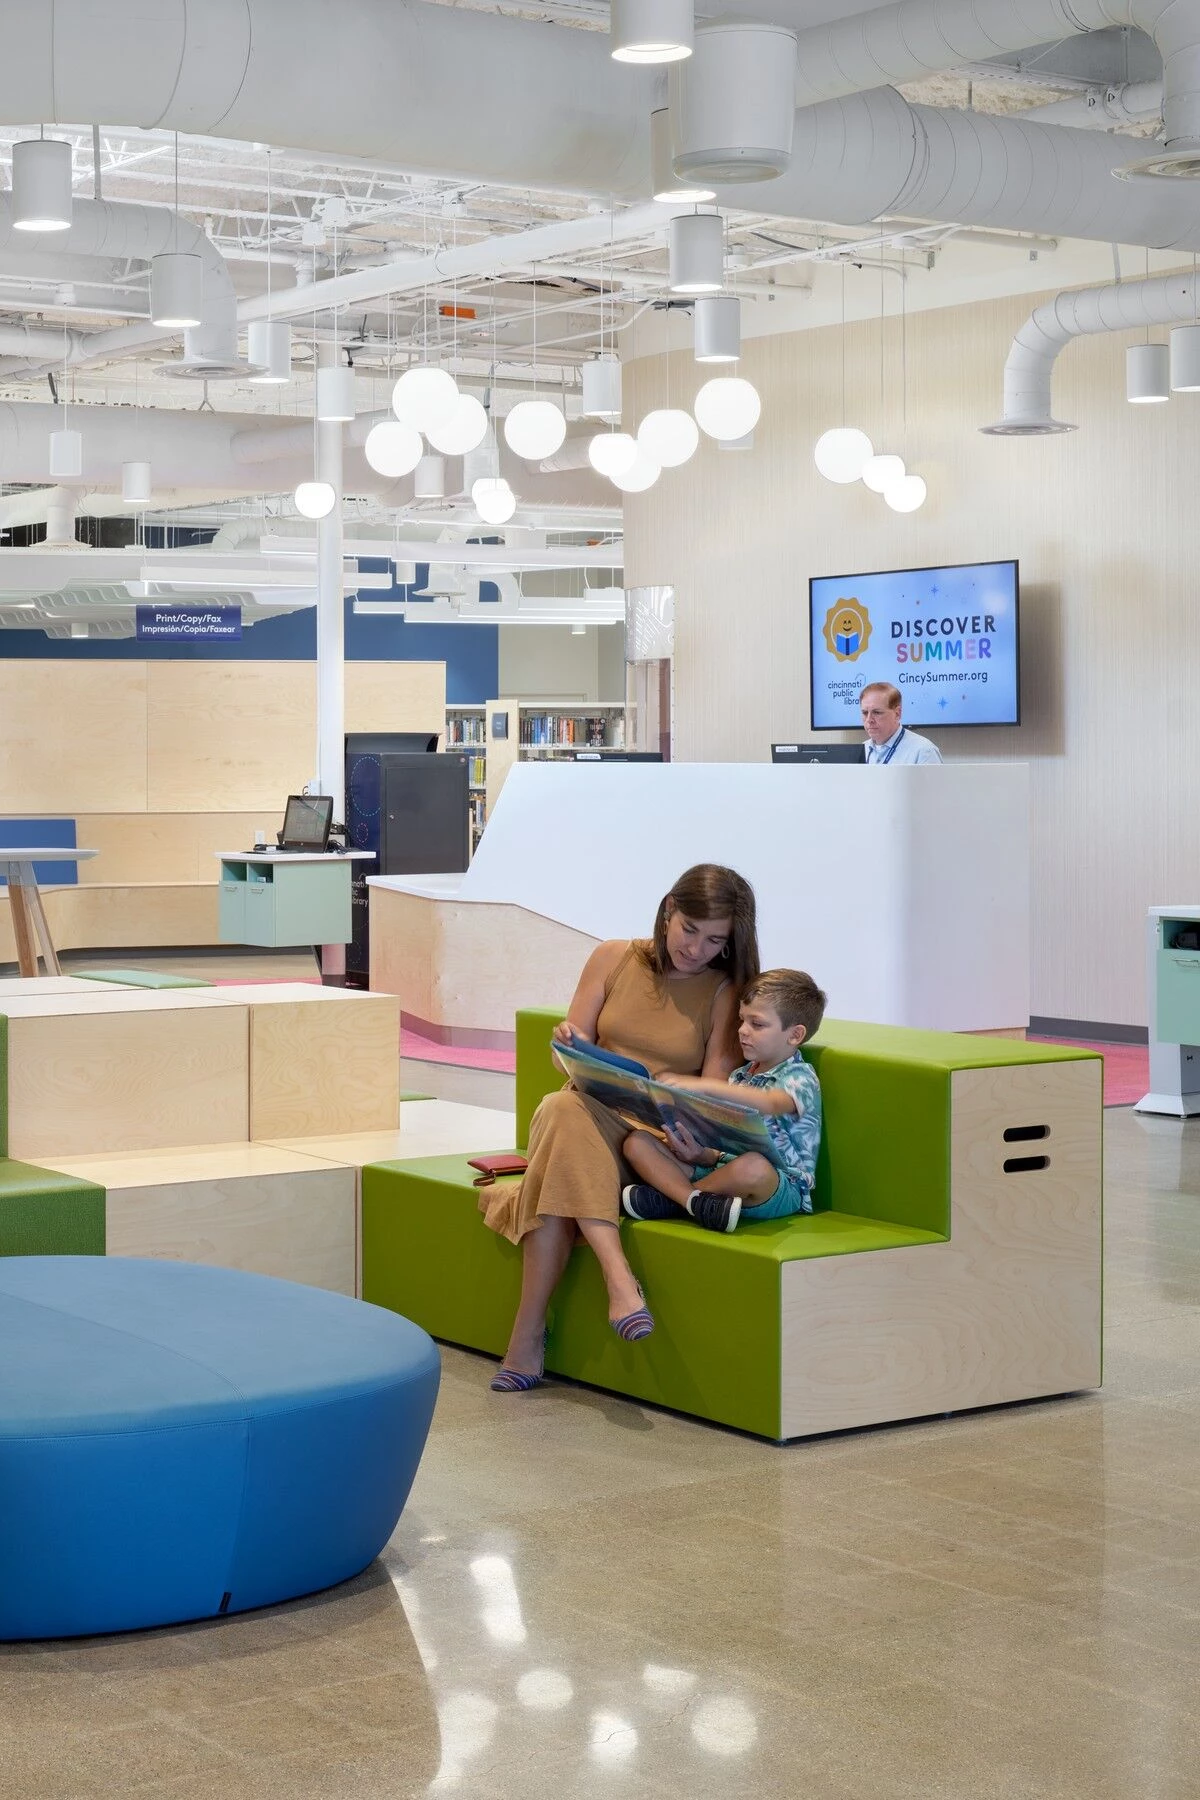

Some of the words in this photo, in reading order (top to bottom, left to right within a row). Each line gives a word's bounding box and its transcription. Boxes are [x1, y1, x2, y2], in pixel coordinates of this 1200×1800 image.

[156, 614, 222, 624] Print/Copy/Fax
[142, 625, 235, 634] Impresión/Copia/Faxear
[891, 615, 996, 638] DISCOVER
[896, 639, 992, 663] SUMMER
[898, 672, 987, 685] CincySummer.org
[827, 680, 862, 689] cincinnati
[833, 689, 854, 699] public
[844, 697, 860, 705] libra
